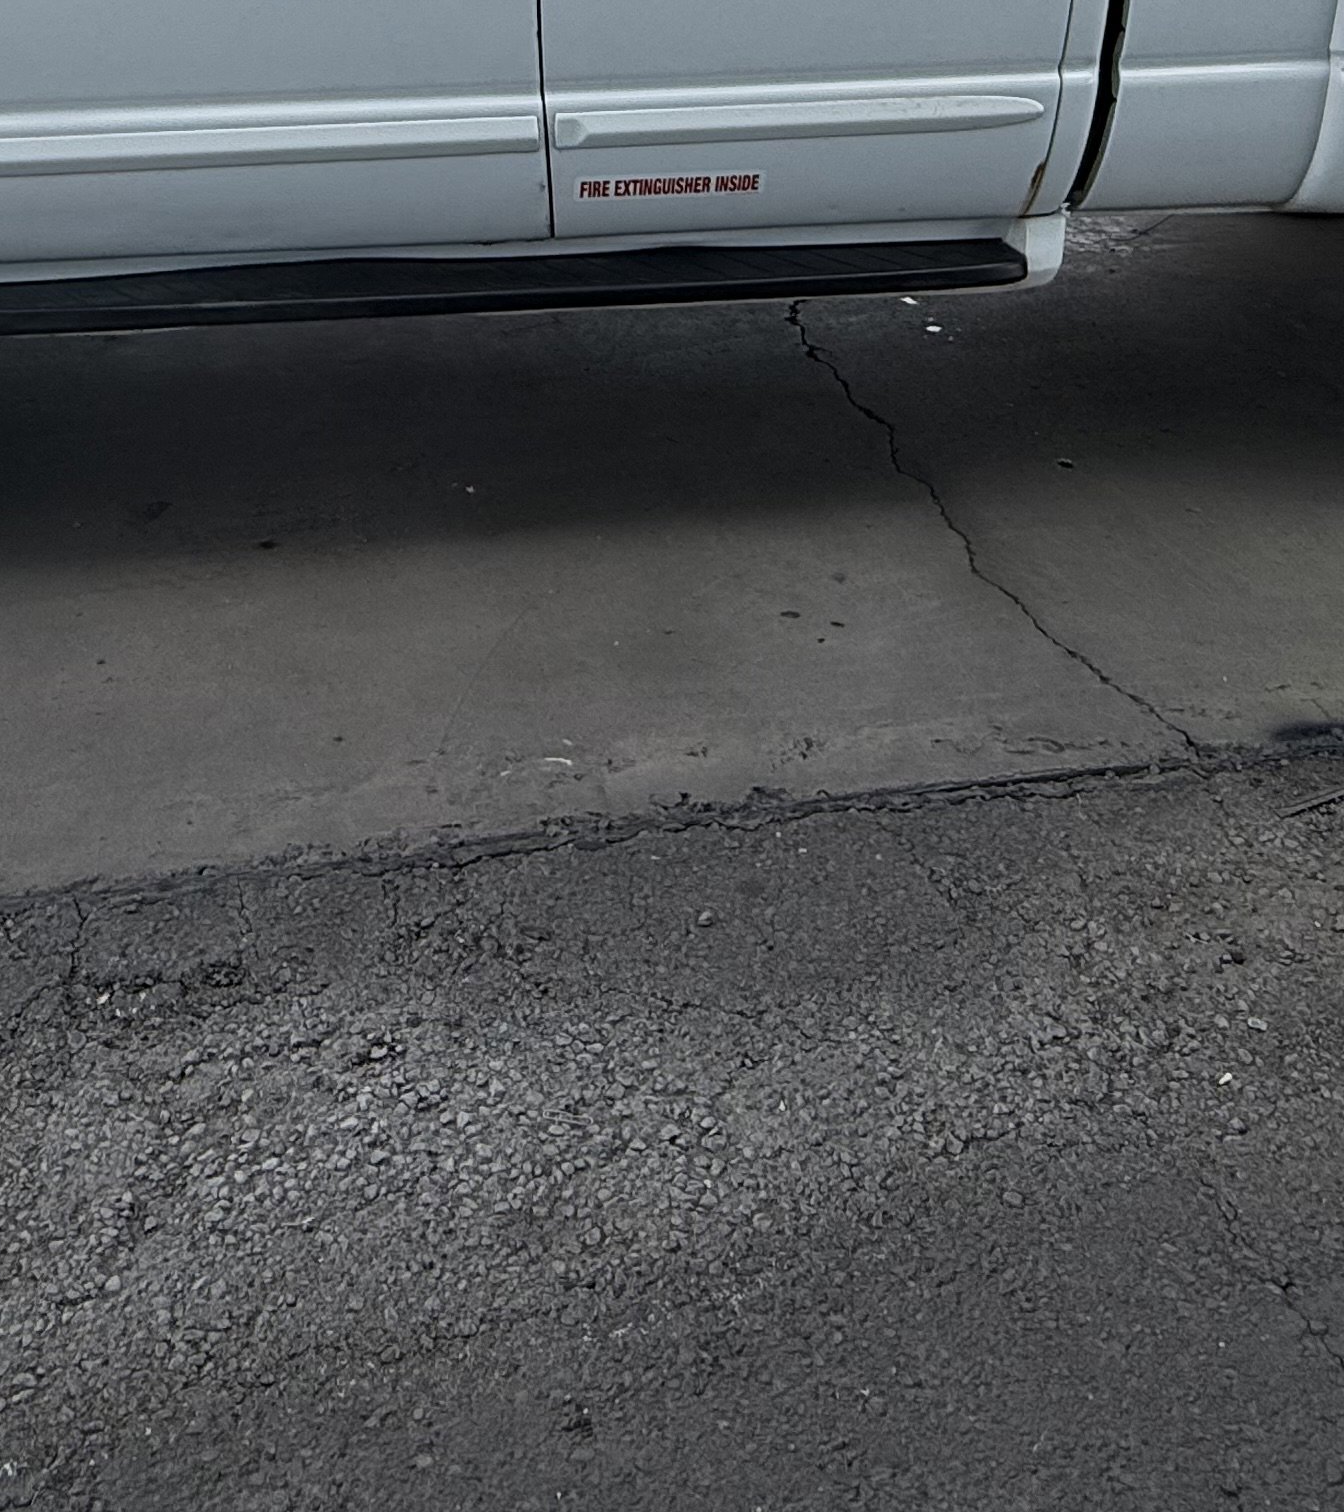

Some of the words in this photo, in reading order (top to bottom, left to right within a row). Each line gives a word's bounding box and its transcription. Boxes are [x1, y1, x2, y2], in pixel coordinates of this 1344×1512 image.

[579, 180, 611, 199] FIRE
[613, 176, 712, 197] EXTINGUISHER
[714, 174, 760, 192] INSIDE
